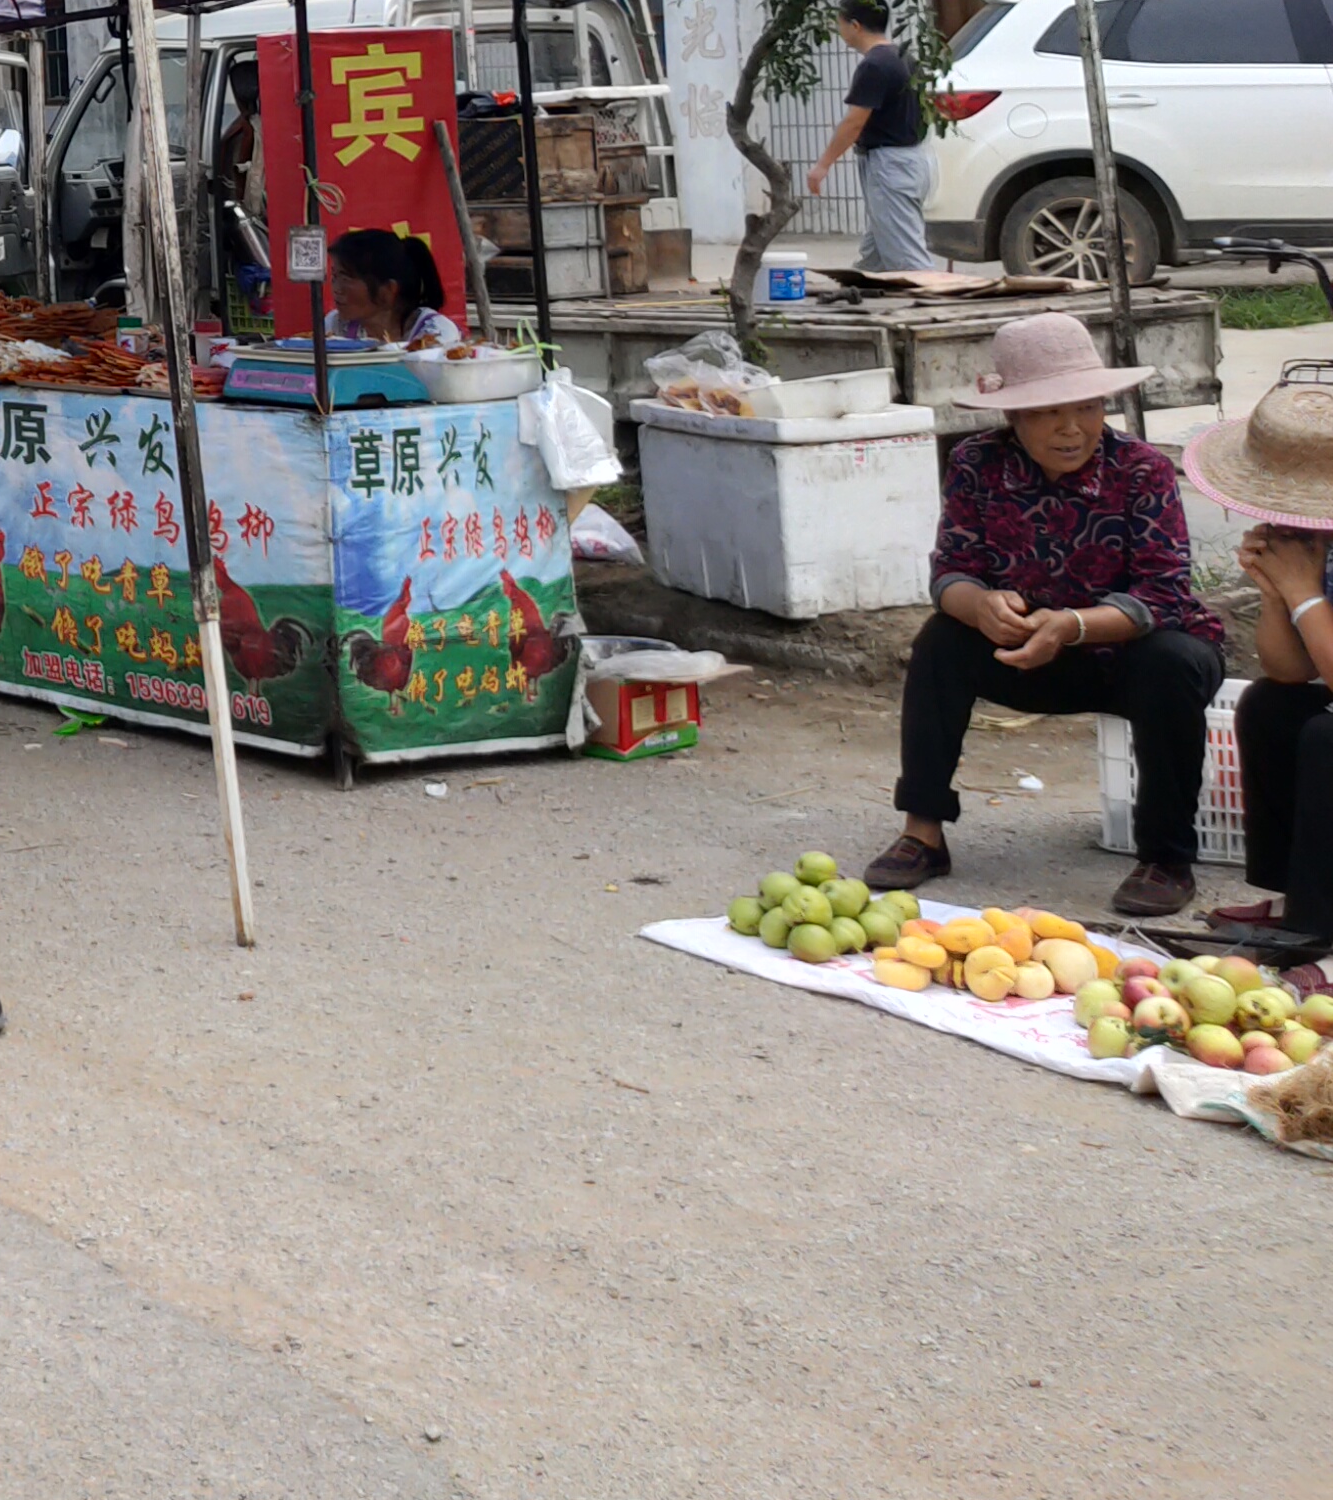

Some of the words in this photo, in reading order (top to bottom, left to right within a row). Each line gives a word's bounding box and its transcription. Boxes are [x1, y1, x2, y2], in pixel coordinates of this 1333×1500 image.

[19, 544, 175, 609] 饿了吃青草
[405, 610, 528, 651] 饿了吃青草
[125, 671, 273, 726] 159639619
